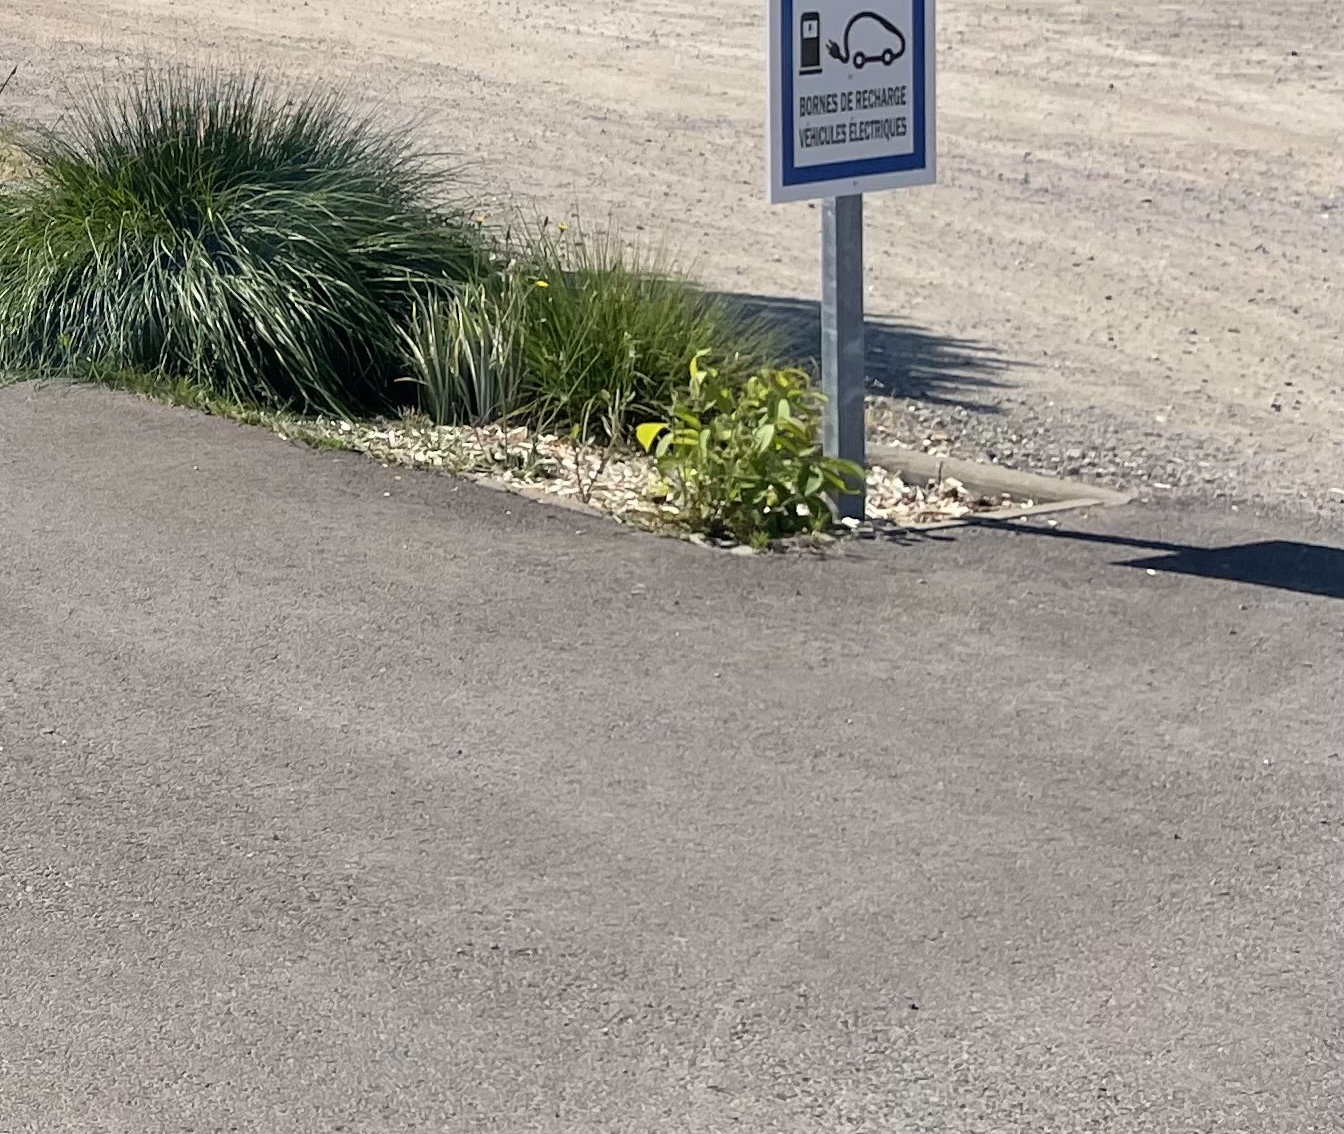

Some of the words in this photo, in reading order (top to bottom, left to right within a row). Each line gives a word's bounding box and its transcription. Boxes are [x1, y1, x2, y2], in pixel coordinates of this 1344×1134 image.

[799, 92, 838, 117] BORNES
[840, 91, 853, 112] DE
[855, 85, 907, 110] RECHARGE
